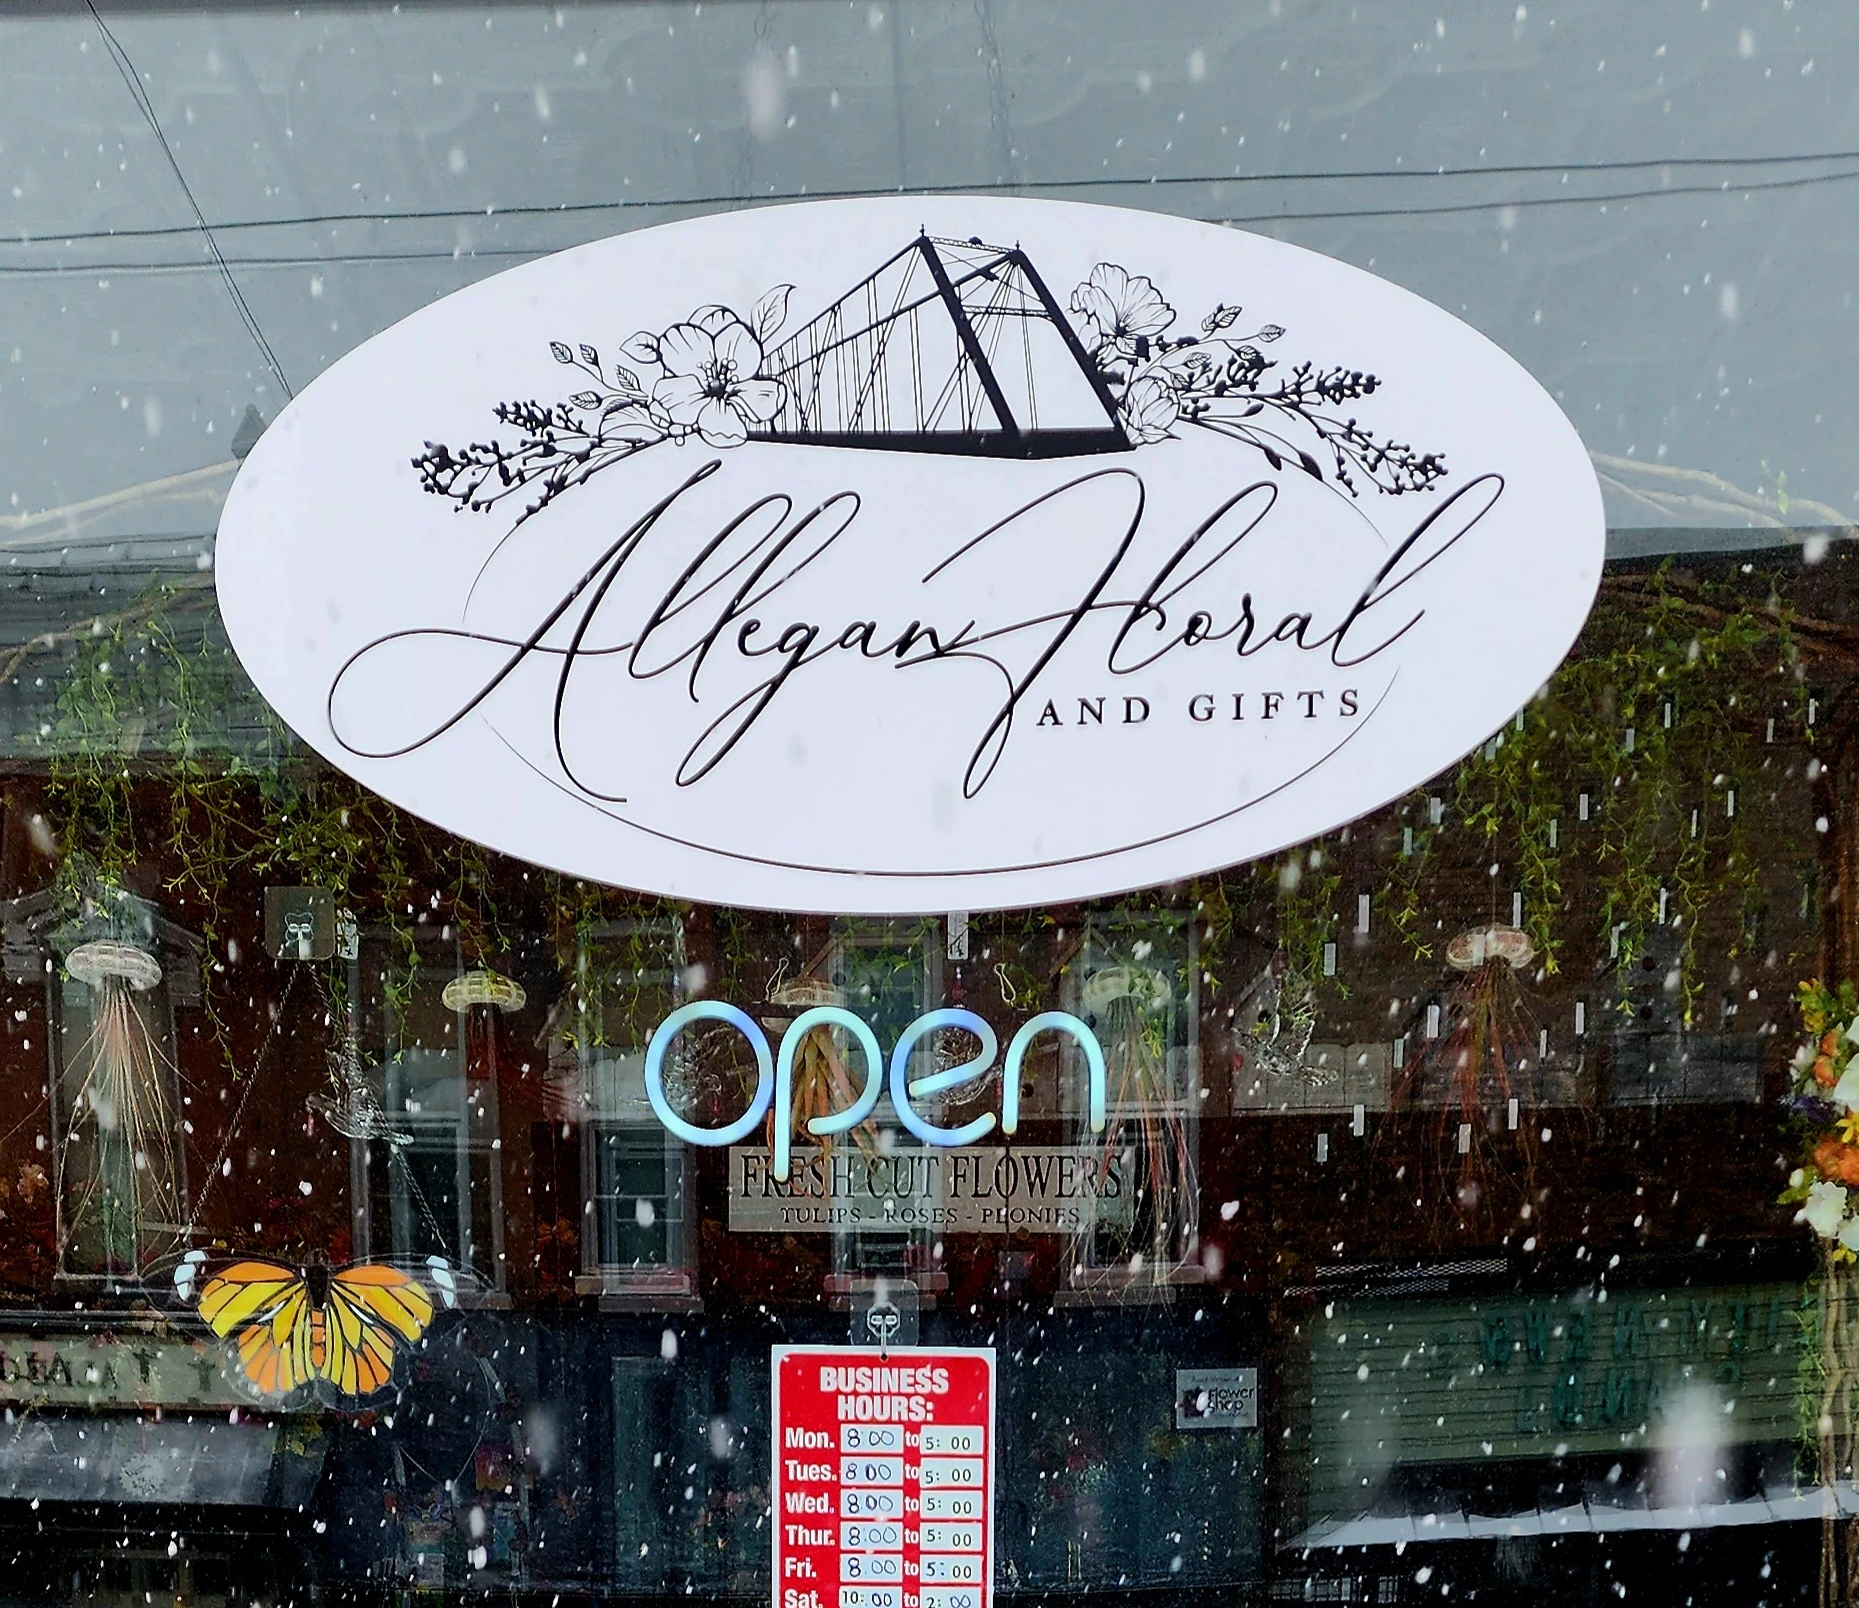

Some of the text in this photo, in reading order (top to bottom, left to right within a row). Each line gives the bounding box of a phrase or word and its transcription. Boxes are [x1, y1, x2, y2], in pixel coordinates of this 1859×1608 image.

[328, 459, 1504, 802] Allegan Floral
[1036, 688, 1362, 727] AND GIFTS
[644, 1000, 1106, 1182] open
[740, 1155, 1122, 1199] FRESH CUT FLOWERS
[780, 1207, 861, 1224] TULIPS
[884, 1207, 958, 1224] ROSES
[981, 1207, 1081, 1224] PEONIES
[819, 1366, 950, 1394] BUSINESS
[836, 1395, 934, 1421] HOURS:
[784, 1427, 835, 1448] Mon.
[904, 1431, 920, 1447] to
[784, 1460, 837, 1482] Tues.
[904, 1464, 919, 1479] to
[784, 1492, 835, 1514] Wed.
[904, 1497, 919, 1511] to
[784, 1525, 836, 1546] Thur.
[904, 1529, 919, 1544] to
[784, 1557, 817, 1578] Fri.
[904, 1560, 919, 1575] to
[904, 1592, 919, 1608] to
